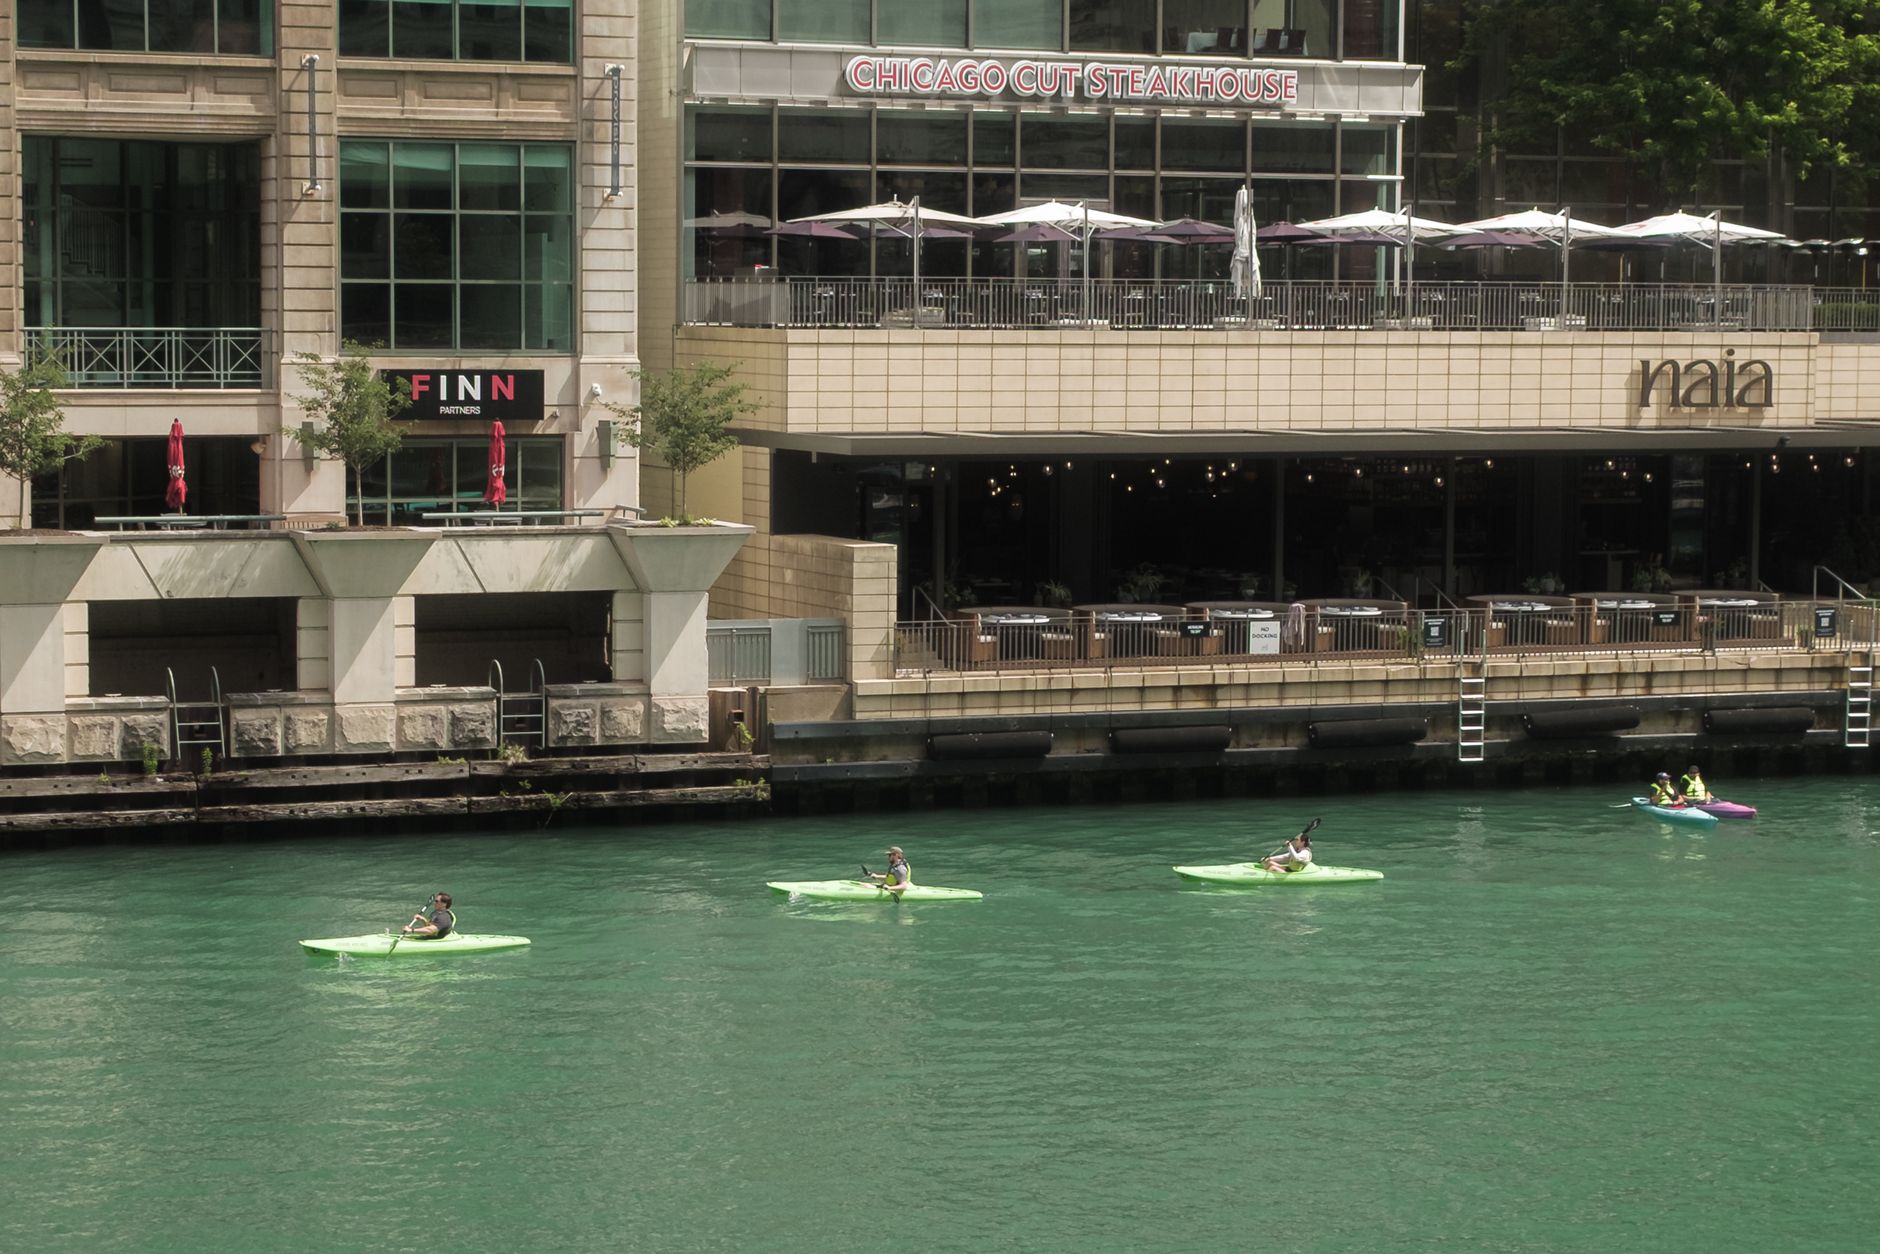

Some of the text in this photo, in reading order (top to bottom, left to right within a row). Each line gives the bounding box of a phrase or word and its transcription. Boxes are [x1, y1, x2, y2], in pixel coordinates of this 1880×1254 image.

[847, 55, 1298, 103] CHICAGO CUT STEAKHOUSE
[411, 374, 515, 401] FINN
[1639, 348, 1774, 407] naia
[439, 406, 481, 415] PARTNERS
